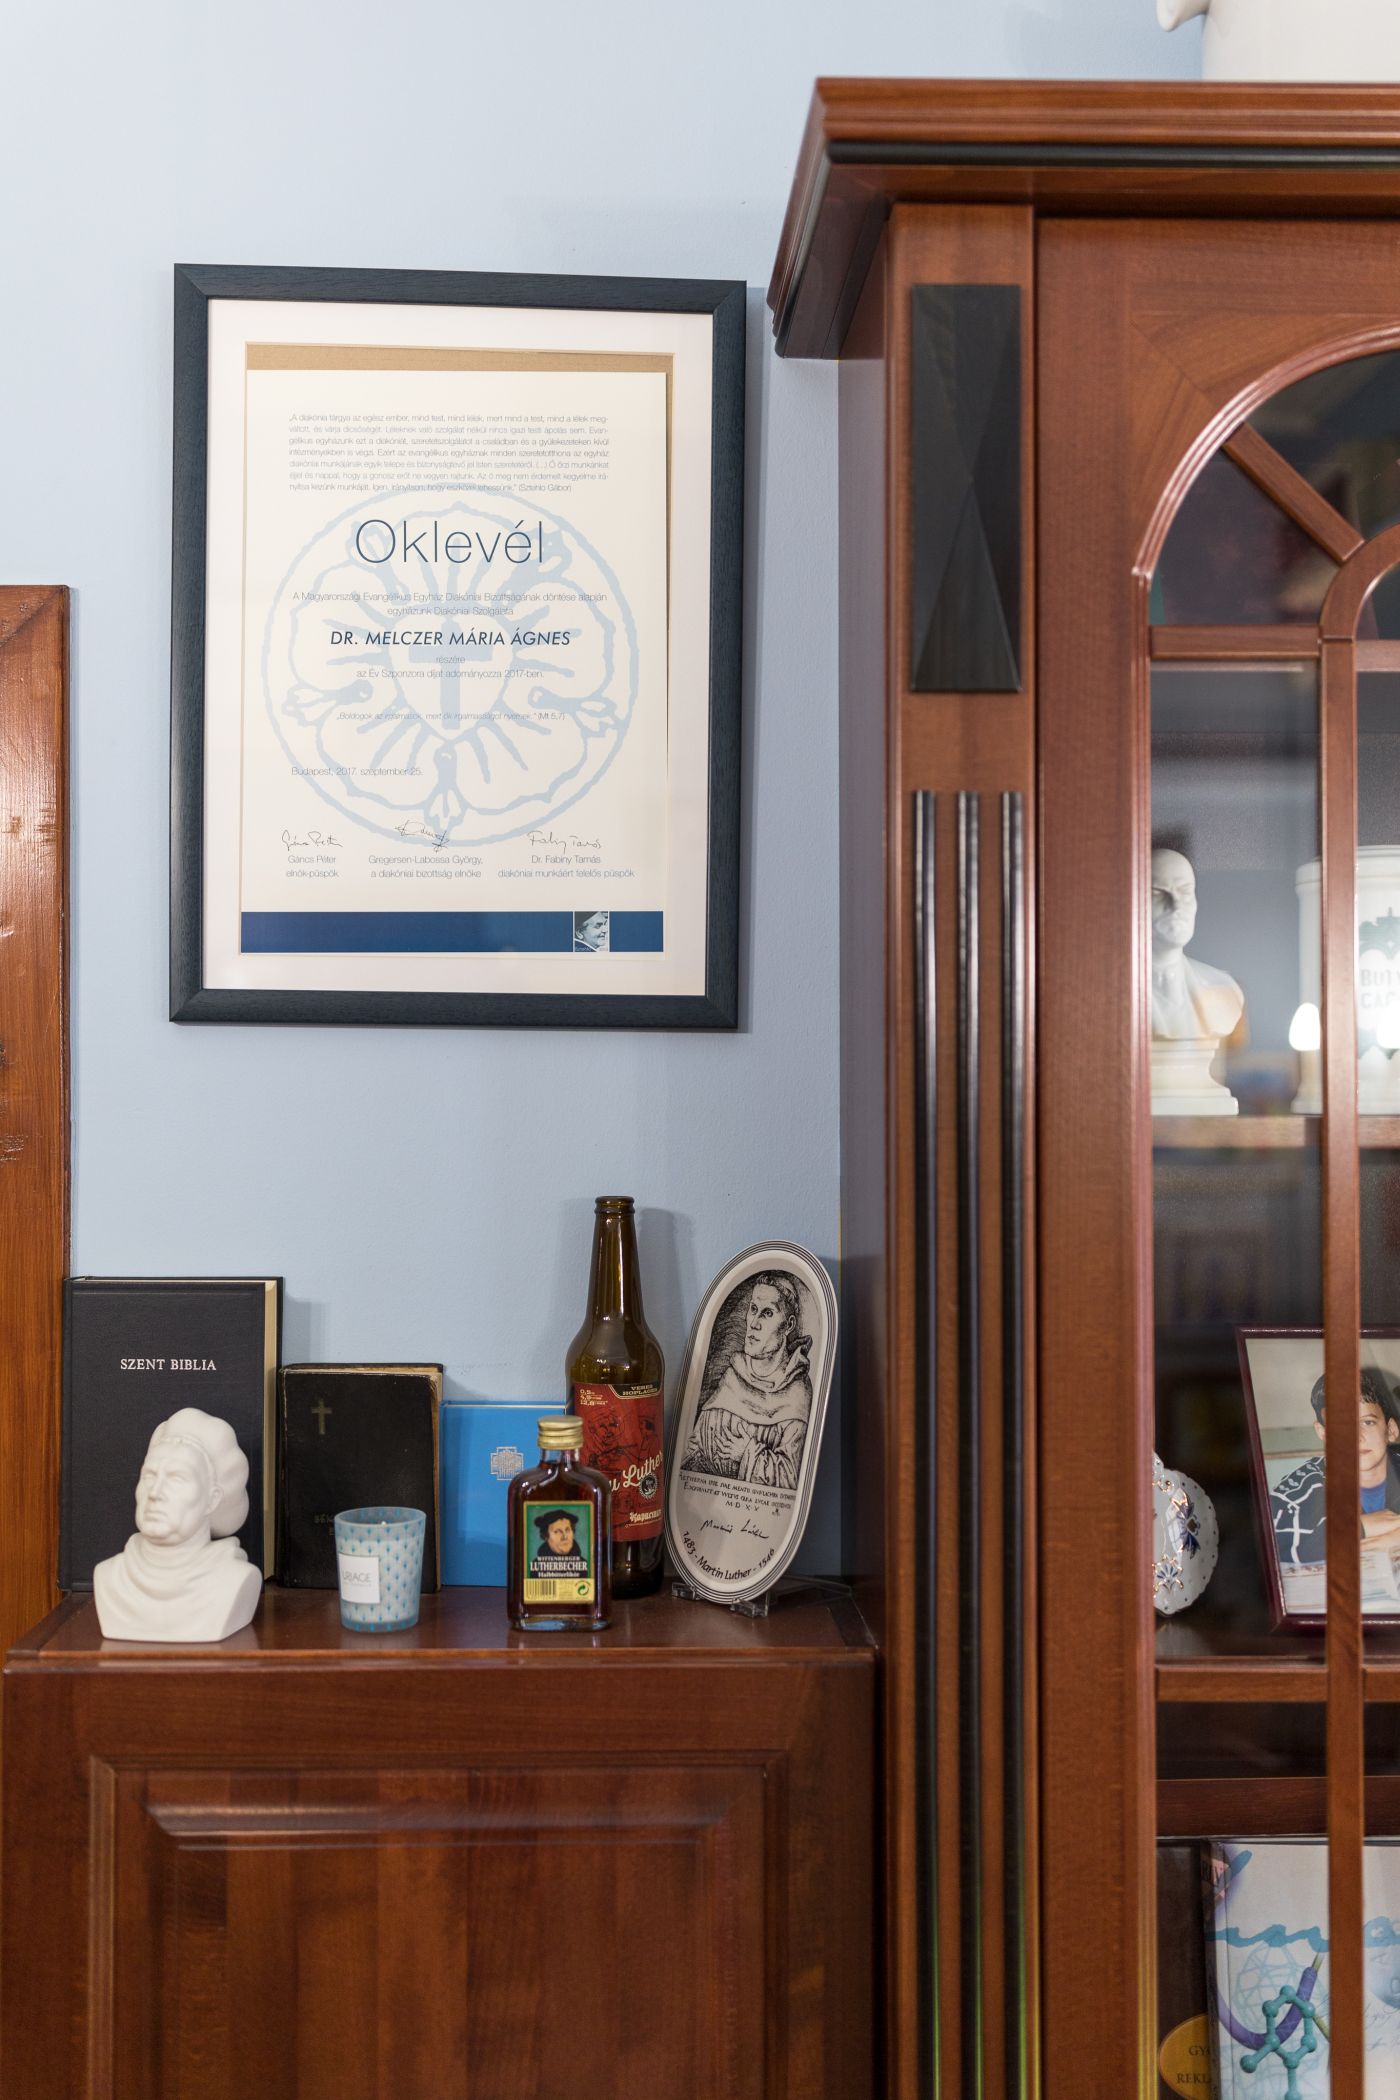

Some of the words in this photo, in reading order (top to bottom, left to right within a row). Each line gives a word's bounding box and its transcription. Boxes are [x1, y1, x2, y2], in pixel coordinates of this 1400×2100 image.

[356, 519, 542, 563] Oklevél
[302, 592, 360, 603] Magyarországi
[363, 592, 411, 603] Evangélikus
[413, 592, 443, 603] Egyház
[446, 592, 481, 601] Diakóniai
[484, 592, 540, 603] Bizottságának
[543, 592, 576, 601] döntése
[578, 592, 607, 603] alapján
[387, 606, 431, 616] egyházunk
[434, 606, 469, 615] Diakóniai
[472, 606, 513, 617] Szolgálata
[330, 631, 358, 645] DR.
[365, 631, 443, 646] MELCZER
[449, 627, 505, 646] MÁRIA
[510, 627, 570, 646] ÁGNES
[436, 655, 465, 664] részére
[288, 855, 314, 864] Gáncs
[316, 855, 336, 864] Péter
[368, 855, 450, 866] Gregersen-Labossa
[531, 855, 542, 864] Dr.
[545, 855, 572, 865] Fabiny
[575, 855, 601, 864] Tamás
[286, 869, 340, 879] elnök-püspök
[378, 869, 414, 878] diakóniai
[416, 869, 452, 880] bizottság
[454, 869, 482, 878] elnöke
[497, 869, 532, 878] diakóniai
[535, 869, 573, 878] munkáért
[576, 869, 602, 878] felelős
[603, 869, 635, 880] püspök
[120, 1358, 166, 1371] SZENT
[170, 1358, 217, 1371] BIBLIA
[530, 1561, 588, 1571] LUTHERBECHER
[697, 1555, 724, 1579] Martin
[724, 1567, 752, 1580] Luther
